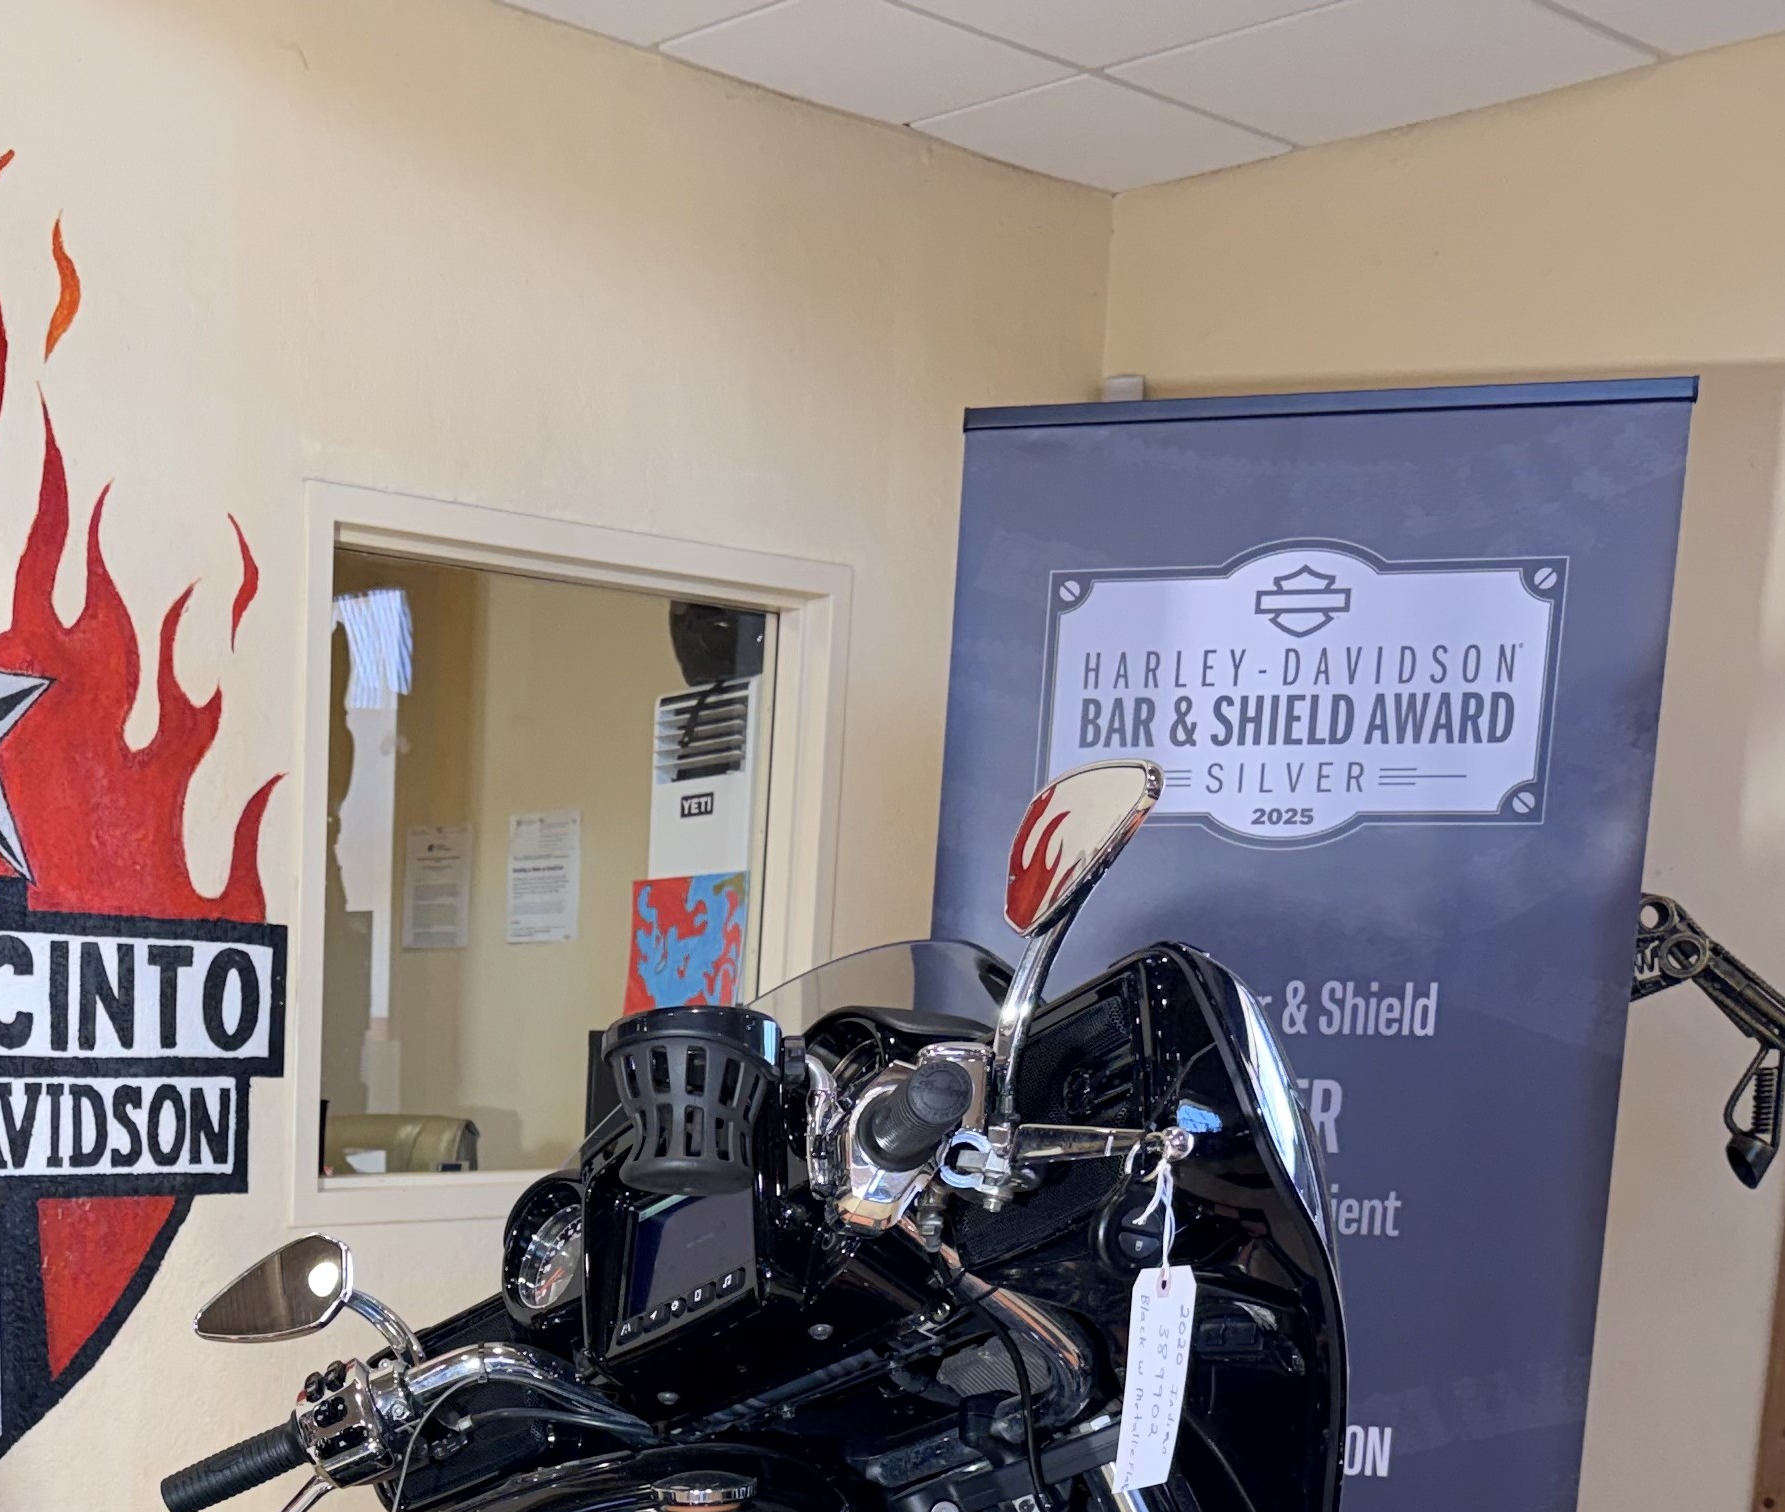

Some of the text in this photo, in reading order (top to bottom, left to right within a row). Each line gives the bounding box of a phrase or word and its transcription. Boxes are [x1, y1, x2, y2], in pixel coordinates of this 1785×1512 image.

[1079, 691, 1515, 749] BAR & SHIELD AWARD
[1205, 761, 1365, 793] SILVER
[681, 796, 712, 815] YETI
[1250, 808, 1315, 826] 2025
[1282, 980, 1439, 1037] & Shield
[1295, 1079, 1343, 1153] R
[1138, 1294, 1151, 1348] Black
[1175, 1304, 1190, 1366] 2020
[1343, 1424, 1392, 1477] ON
